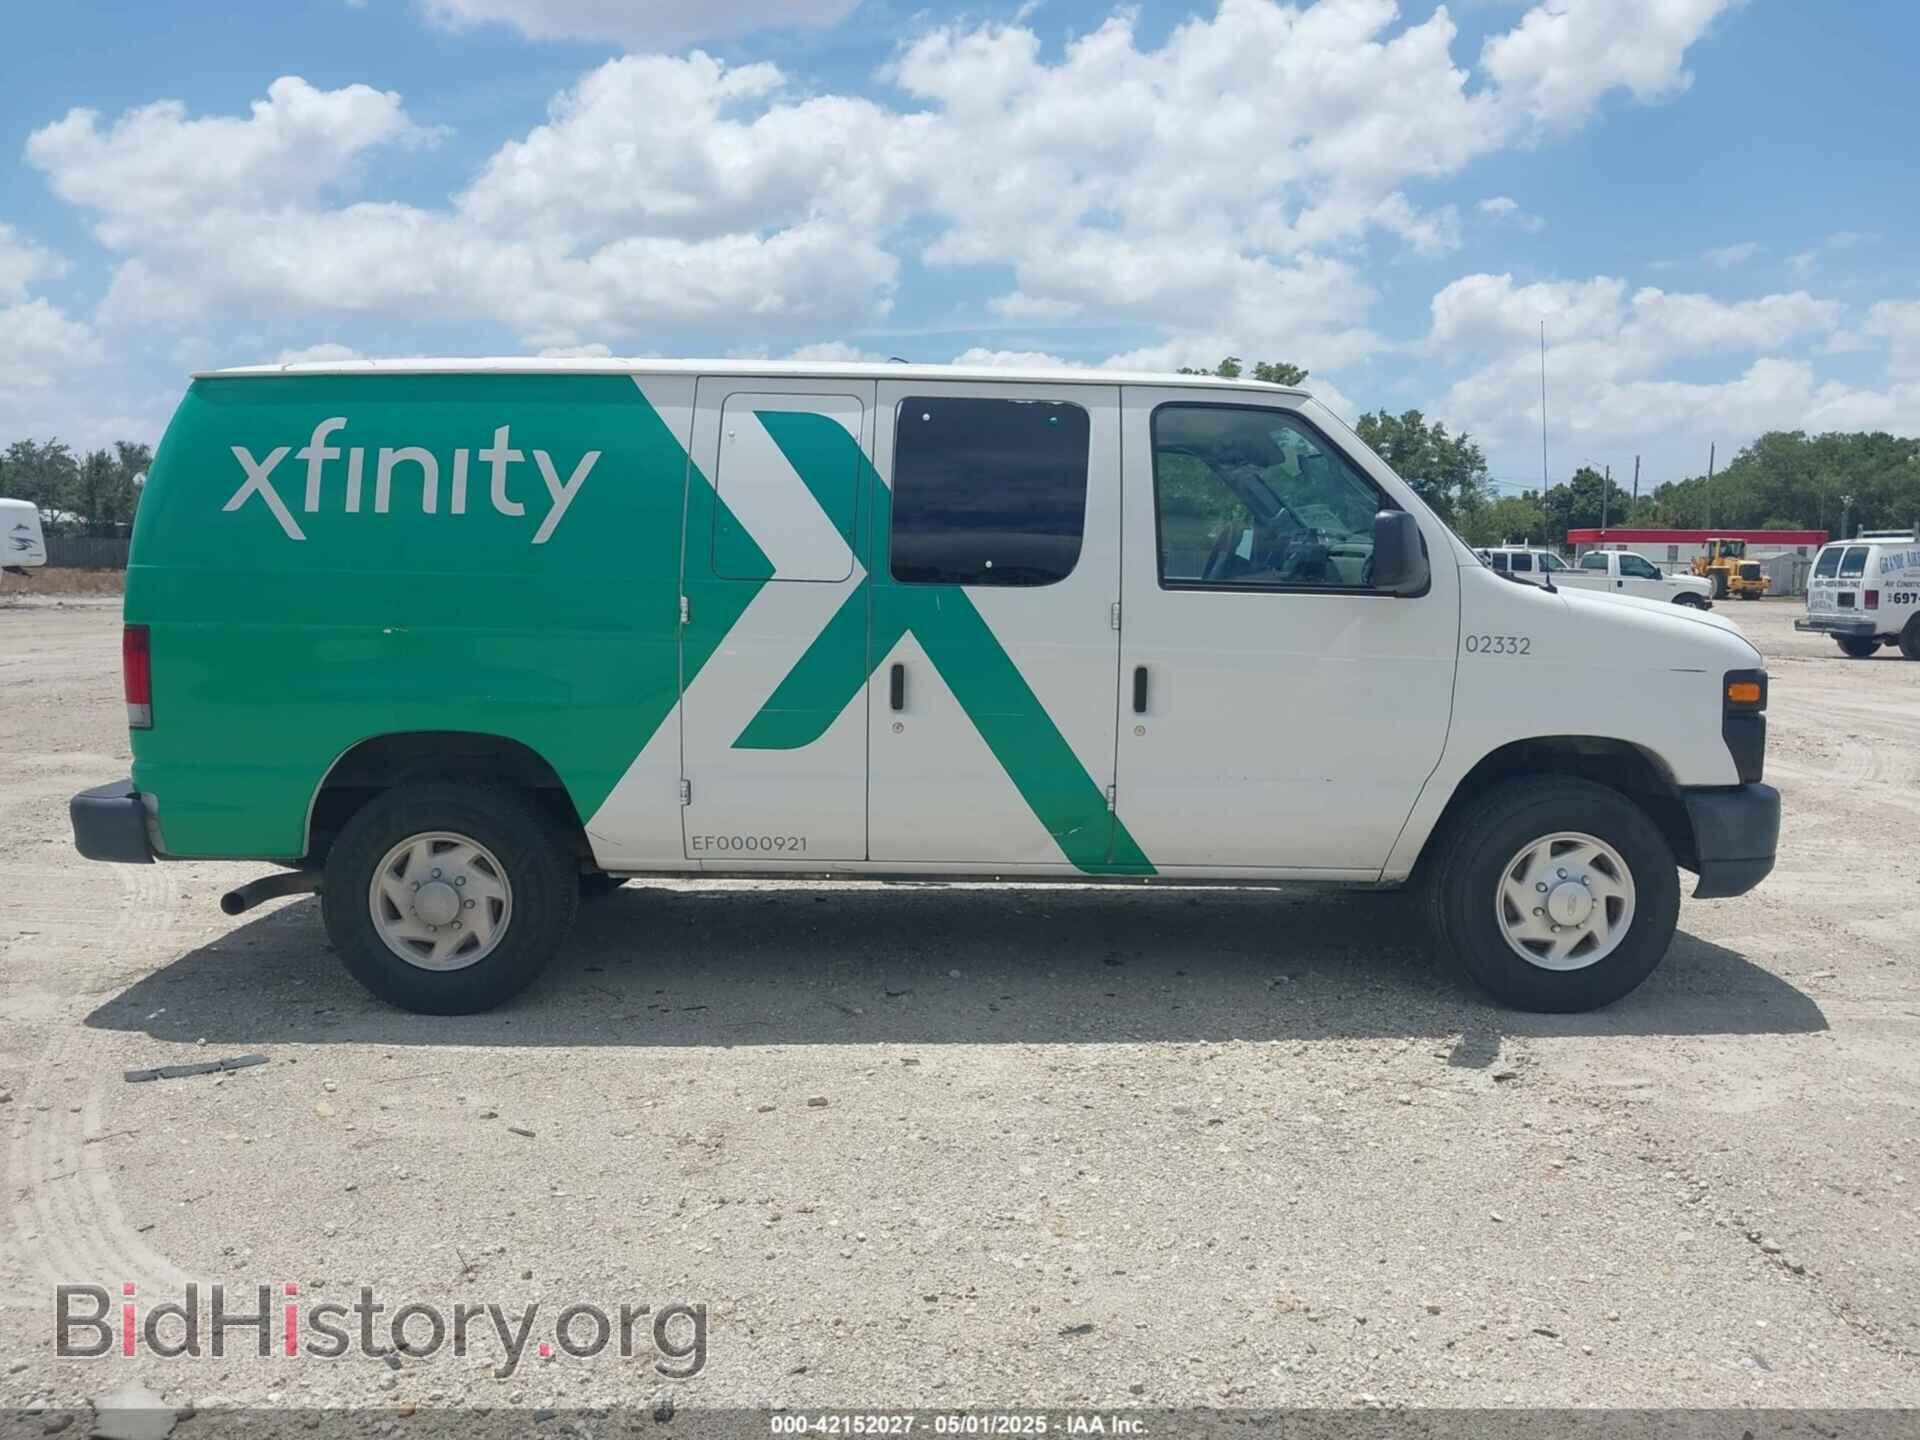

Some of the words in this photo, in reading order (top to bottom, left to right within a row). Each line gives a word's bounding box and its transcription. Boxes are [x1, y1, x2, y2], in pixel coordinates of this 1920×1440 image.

[222, 417, 602, 544] xfinity
[1465, 634, 1531, 655] 02332
[692, 835, 807, 852] EF0000921
